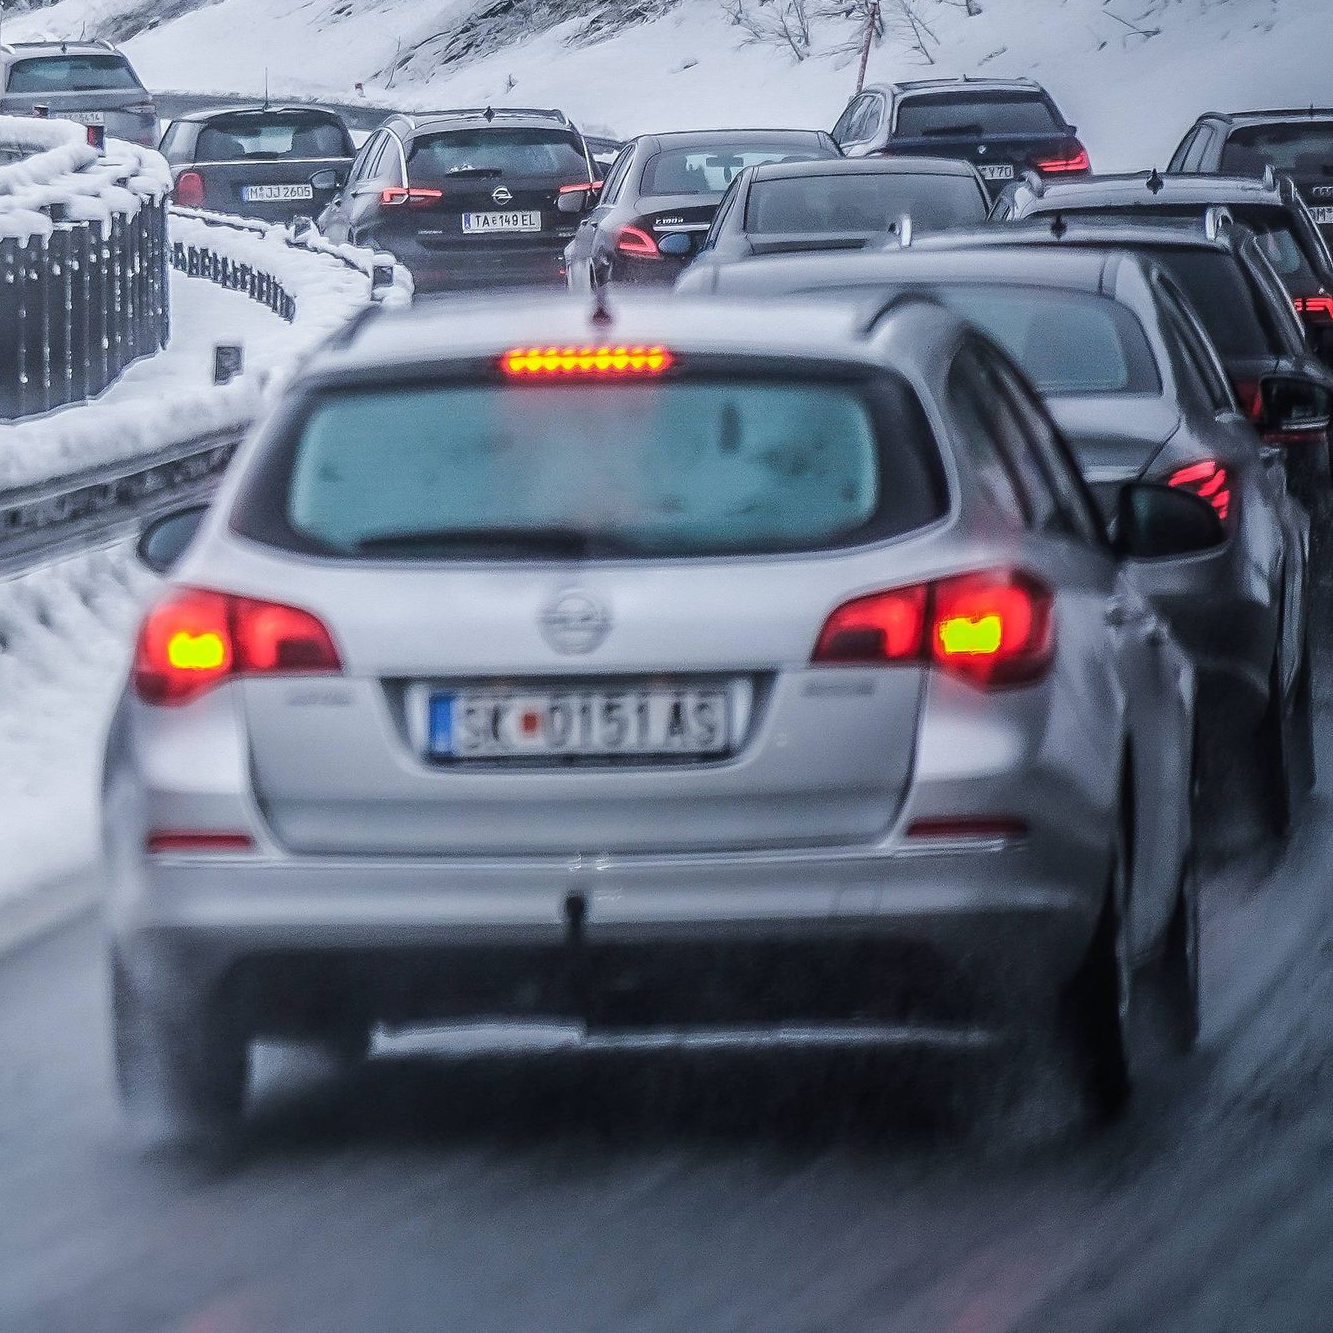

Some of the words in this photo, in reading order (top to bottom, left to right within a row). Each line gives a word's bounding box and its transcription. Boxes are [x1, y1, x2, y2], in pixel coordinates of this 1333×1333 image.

[475, 215, 490, 227] TA
[499, 214, 518, 226] 149
[522, 214, 536, 226] EL
[546, 701, 651, 748] 0151
[665, 700, 720, 747] AS
